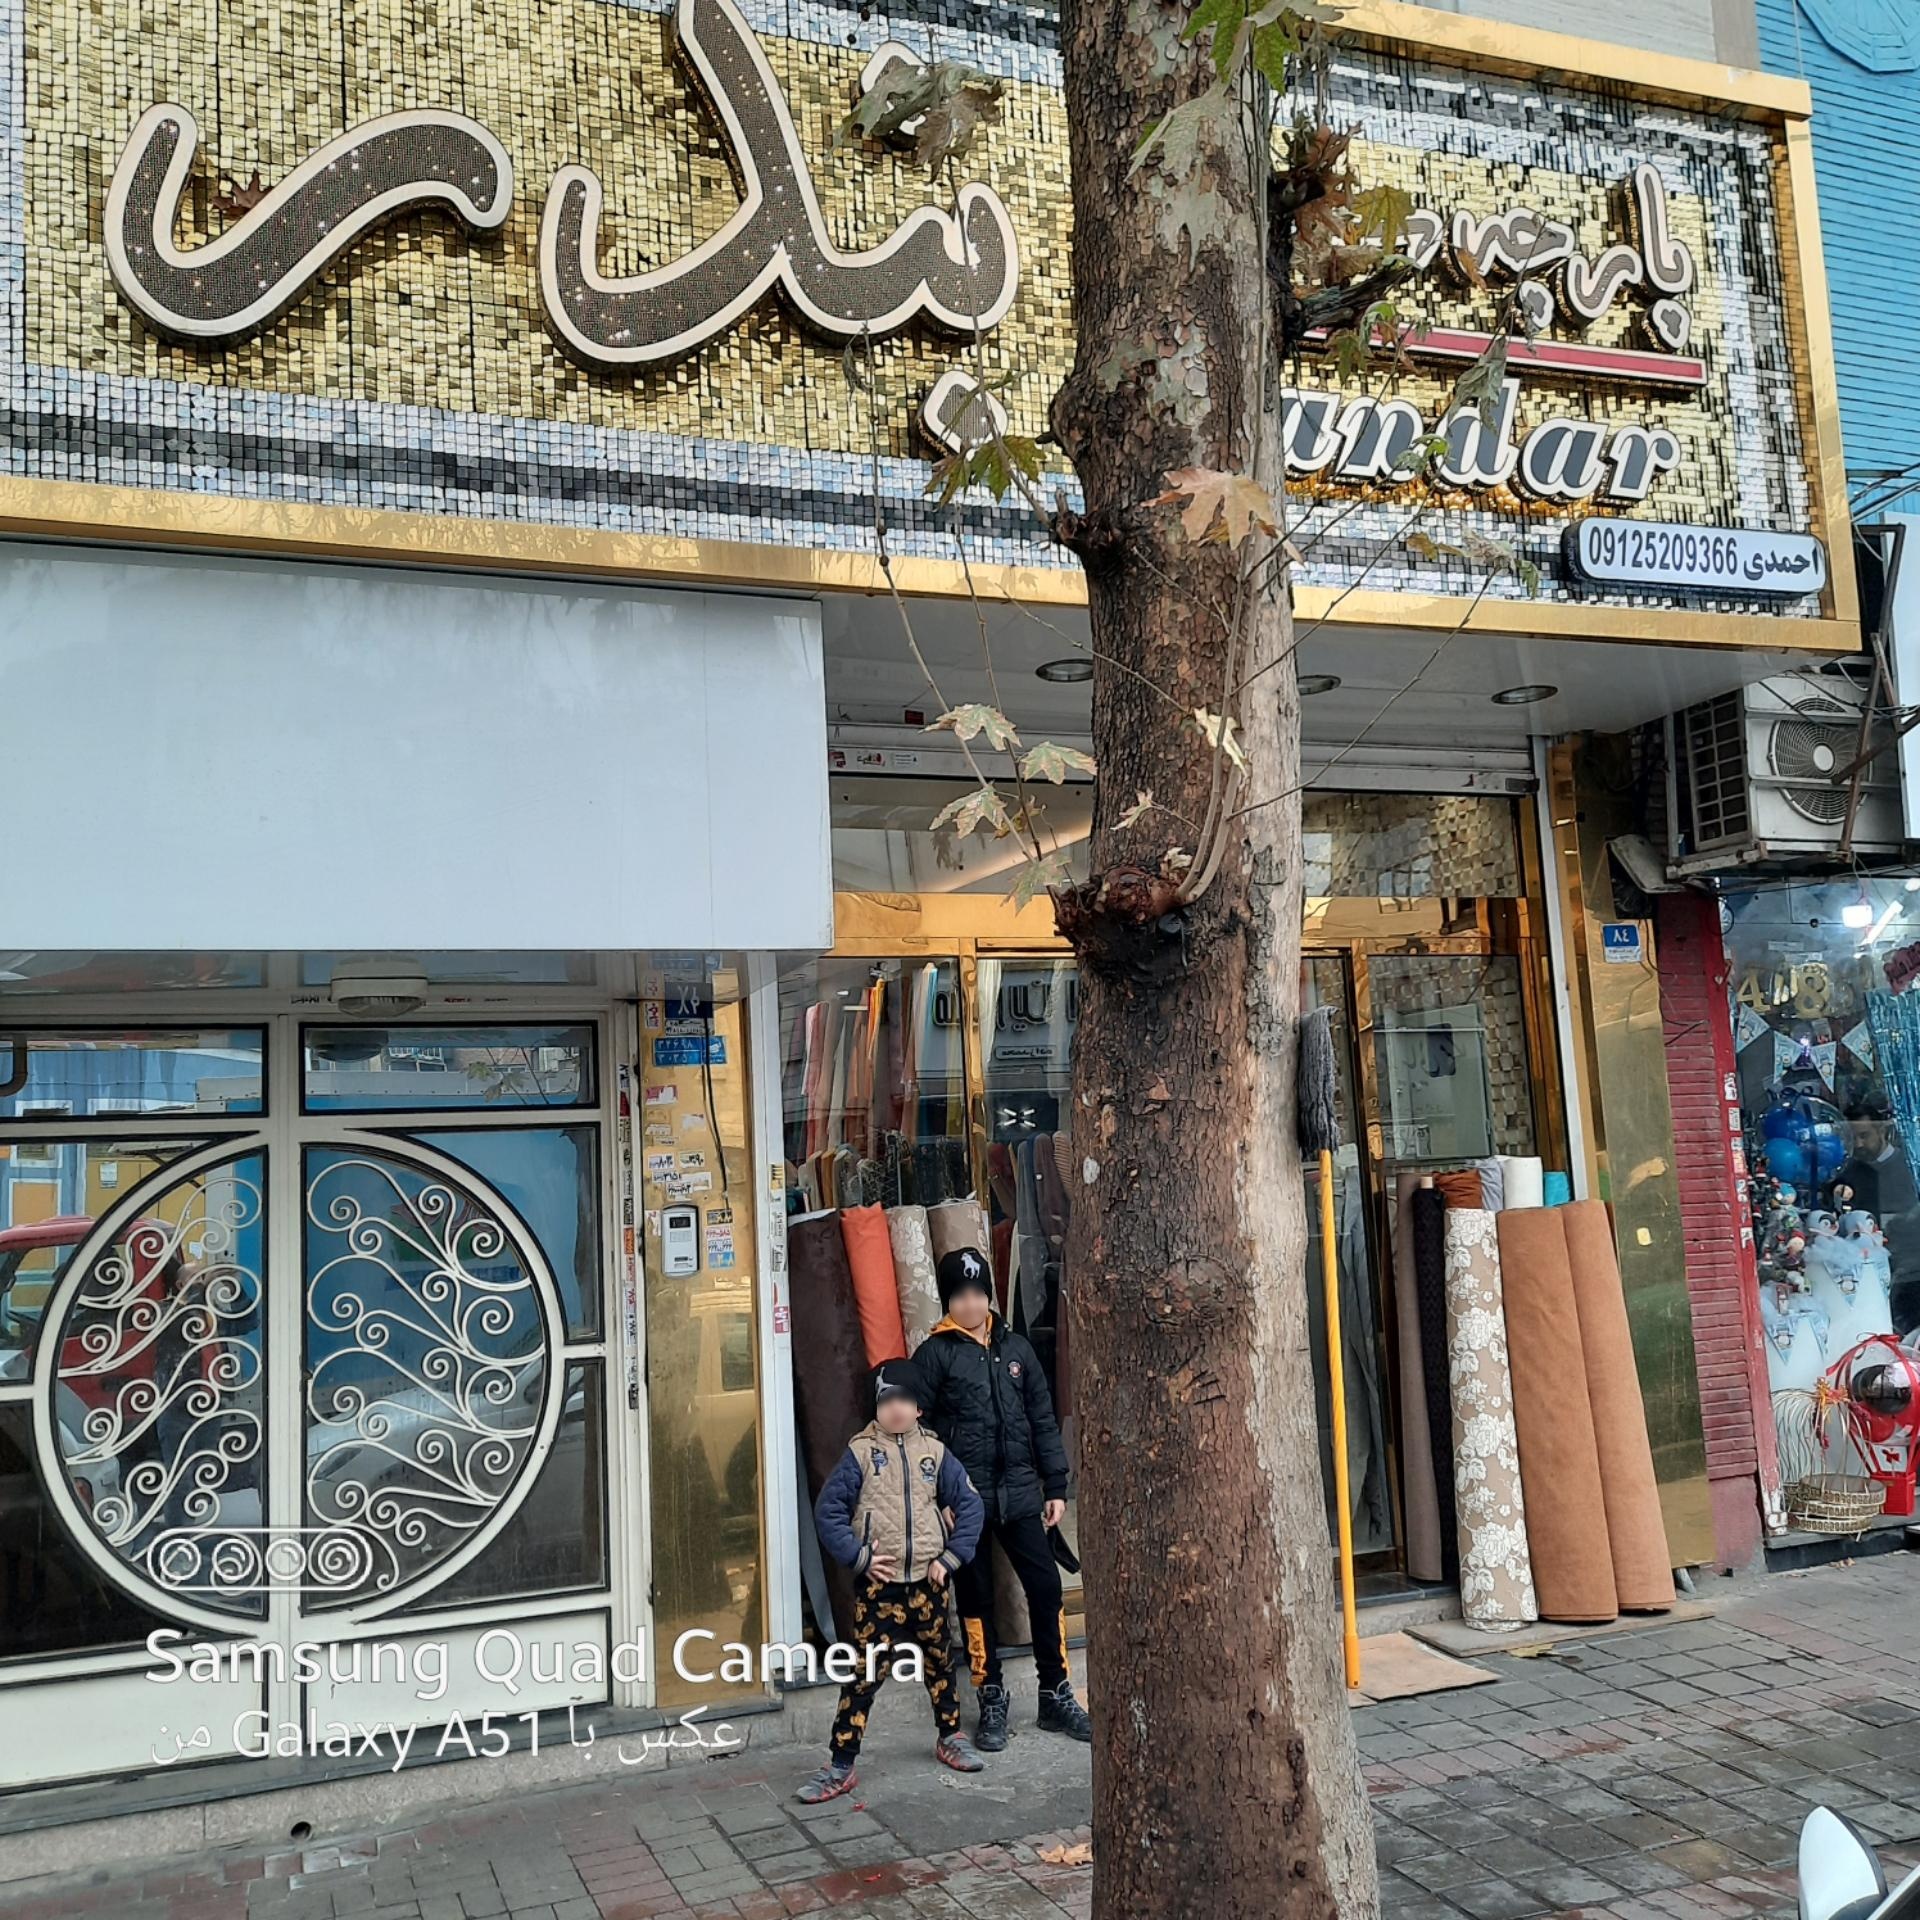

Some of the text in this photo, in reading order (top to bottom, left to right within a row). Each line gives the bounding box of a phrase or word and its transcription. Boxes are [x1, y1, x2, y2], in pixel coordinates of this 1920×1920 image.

[1281, 378, 1681, 500] andar
[1588, 525, 1820, 581] احمدی 09125209366
